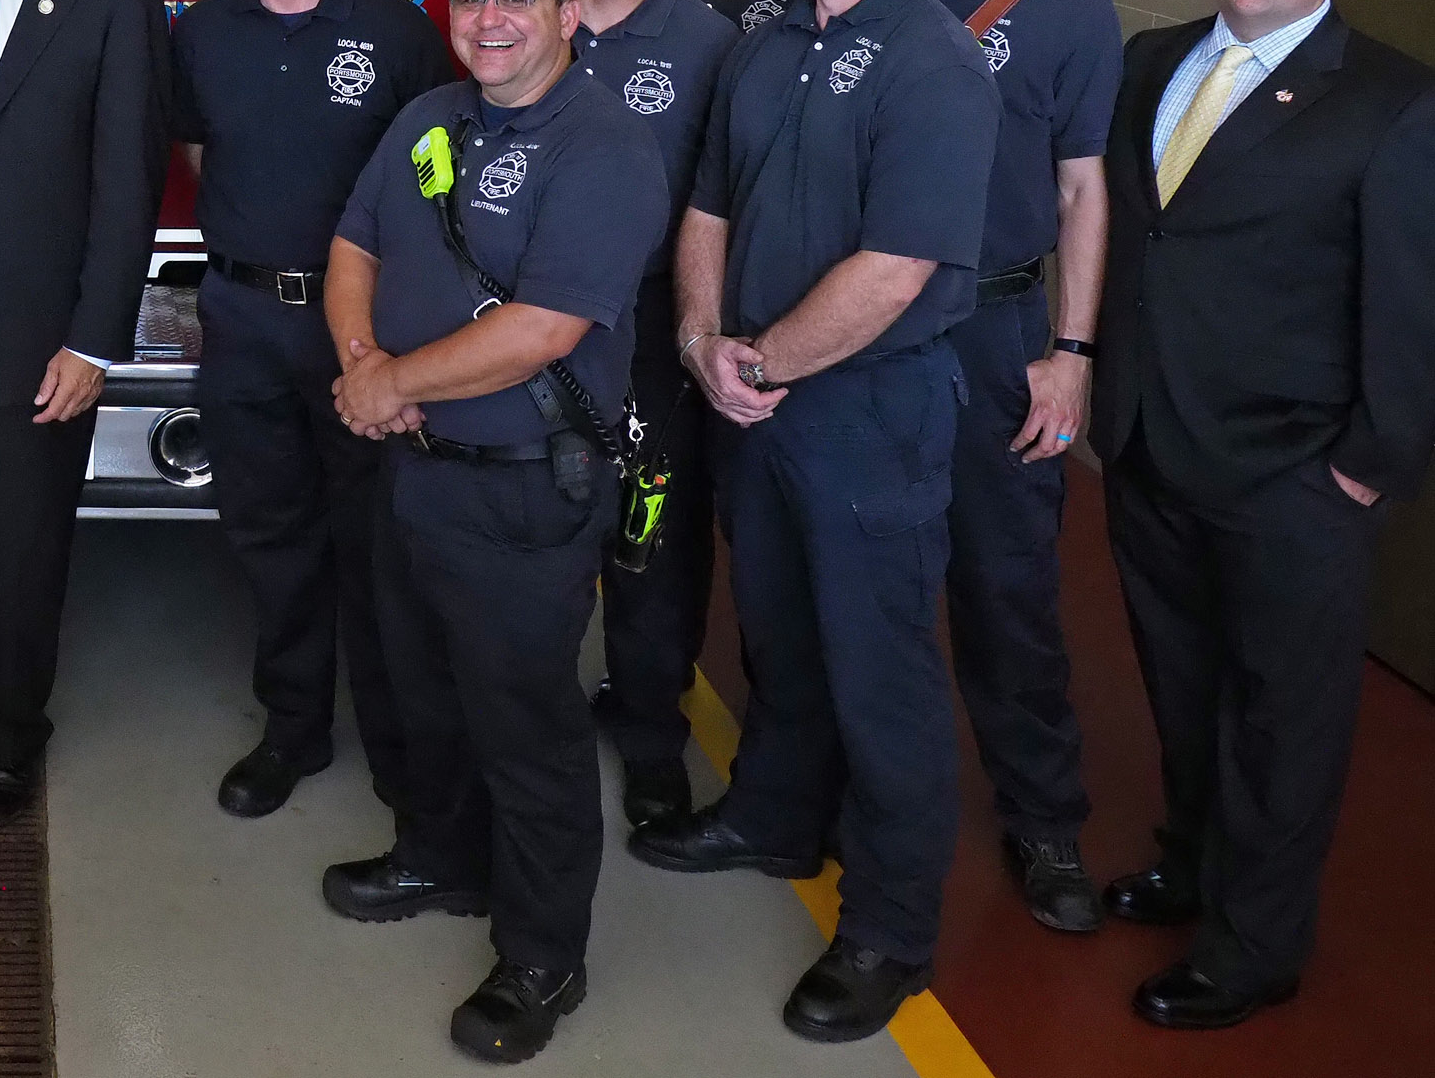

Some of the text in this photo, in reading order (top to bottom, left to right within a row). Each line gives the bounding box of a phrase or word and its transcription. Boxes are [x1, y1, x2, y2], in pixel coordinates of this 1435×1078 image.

[337, 38, 359, 49] LOCAL
[637, 58, 658, 67] LOCAL
[329, 68, 373, 81] PORTSMOUTH
[627, 87, 672, 99] PORTSMOUTH
[330, 95, 362, 107] CAPTAIN
[486, 187, 501, 196] FIRE
[470, 199, 510, 216] LIEUTENANT
